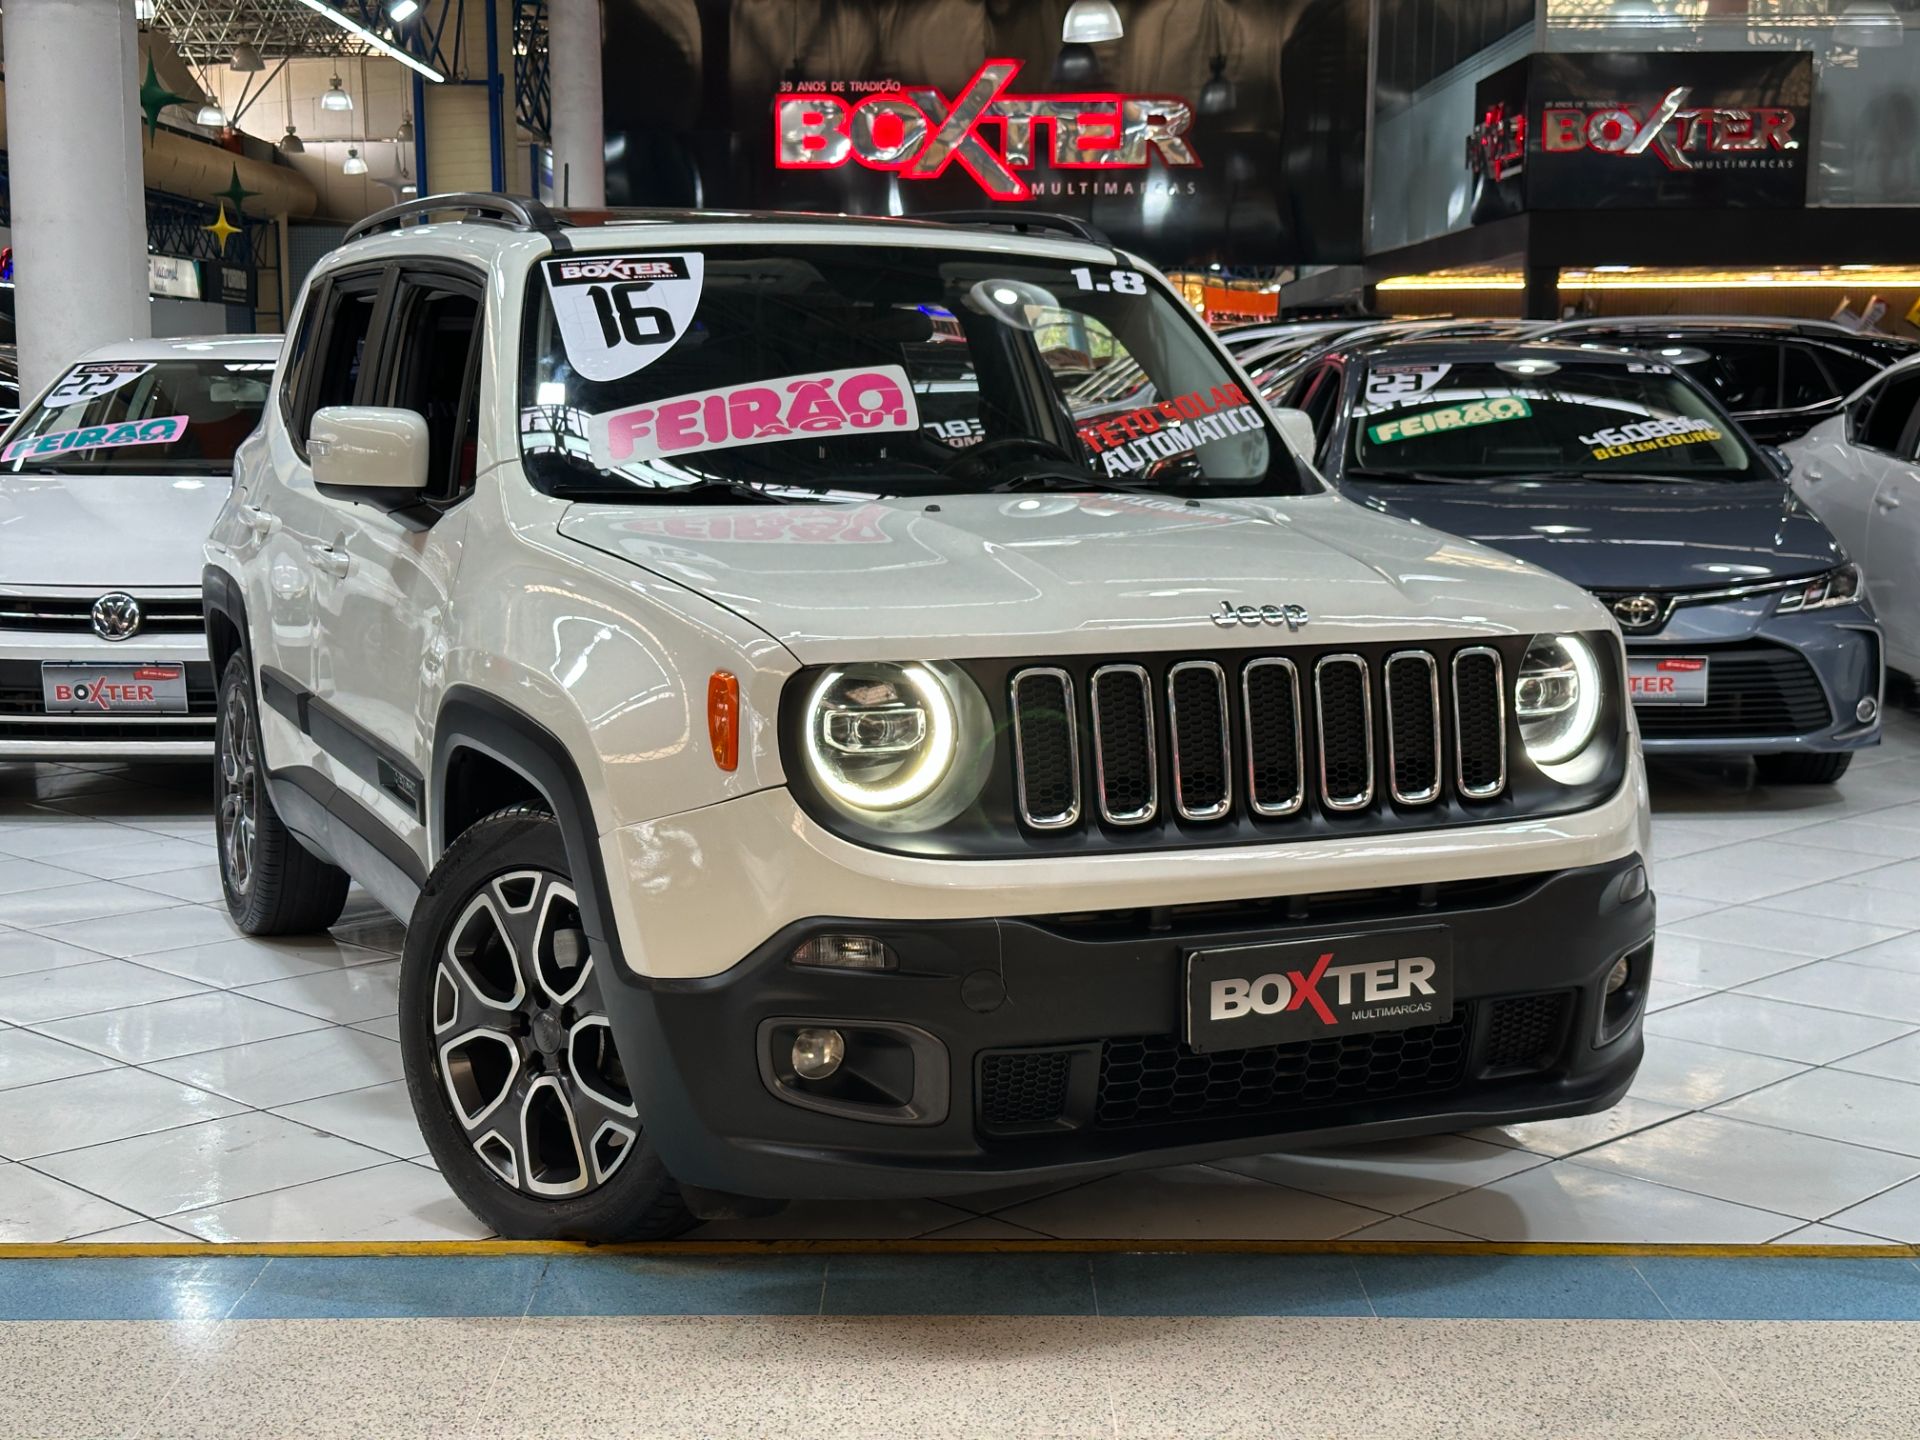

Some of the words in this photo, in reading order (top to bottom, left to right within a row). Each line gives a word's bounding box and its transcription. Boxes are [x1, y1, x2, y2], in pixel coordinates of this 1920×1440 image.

[780, 81, 792, 92] 39
[797, 81, 826, 92] ANOS
[831, 81, 844, 92] DE
[849, 79, 901, 93] TRADIÇÃO
[775, 58, 1204, 201] BOXTER
[1542, 86, 1799, 171] BOXTER
[1694, 160, 1794, 170] MULTIMARCAS
[560, 259, 674, 280] BOXTER
[1070, 267, 1147, 295] 1.8
[586, 281, 676, 349] 16
[84, 364, 140, 373] BOXTER
[1370, 373, 1423, 393] 23
[1626, 363, 1672, 375] 2.0
[52, 373, 120, 397] 22
[608, 373, 904, 460] FEIRÃO
[1077, 406, 1160, 453] TETO
[1158, 383, 1250, 422] SOLAR
[1376, 397, 1525, 442] FEIRÃO
[9, 419, 178, 458] FEIRÃO
[1210, 600, 1309, 633] Jeep
[55, 676, 155, 710] BOXTER
[1627, 676, 1675, 693] TER
[1210, 952, 1437, 1025] BOXTER
[1351, 1002, 1433, 1021] MULTIMARCAS
